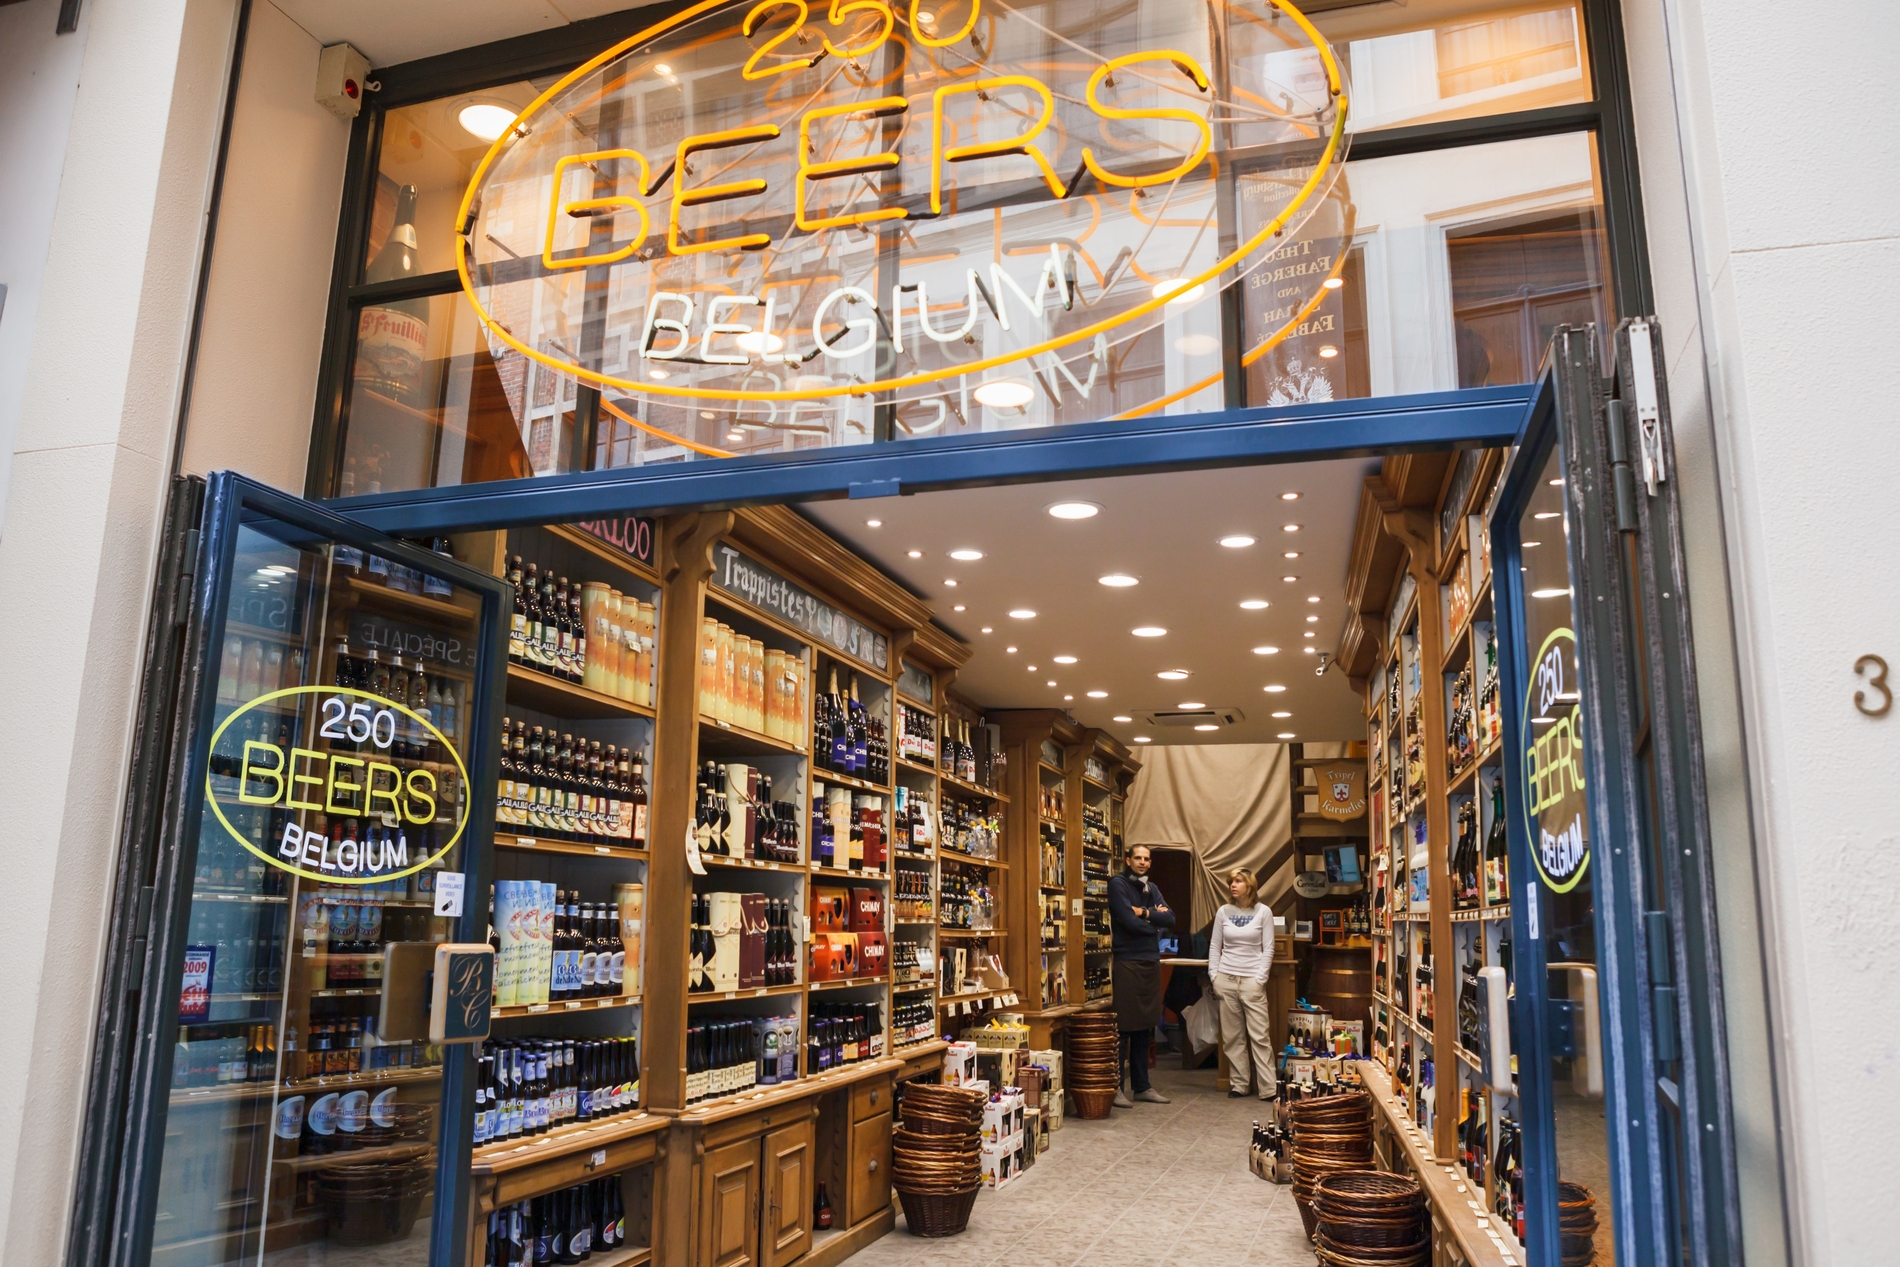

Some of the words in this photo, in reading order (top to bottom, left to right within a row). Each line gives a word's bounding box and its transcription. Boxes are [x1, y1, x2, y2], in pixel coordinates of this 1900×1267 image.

[742, 0, 981, 80] 250
[542, 48, 1212, 270] BEERS
[638, 242, 1075, 366] BELGIUM
[721, 546, 805, 623] Trappistes
[1538, 645, 1563, 716] 250
[1854, 653, 1893, 717] 3
[319, 697, 396, 749] 250
[239, 740, 437, 825] BEERS
[1326, 770, 1355, 780] Tripel
[1321, 798, 1366, 814] Karmeliet
[279, 821, 408, 873] BELGIUM
[1541, 812, 1584, 878] BELGIUM
[860, 901, 881, 914] CHIMAY
[183, 961, 207, 974] 2009
[864, 945, 885, 958] CHIMAY
[1289, 1016, 1313, 1025] Trappist
